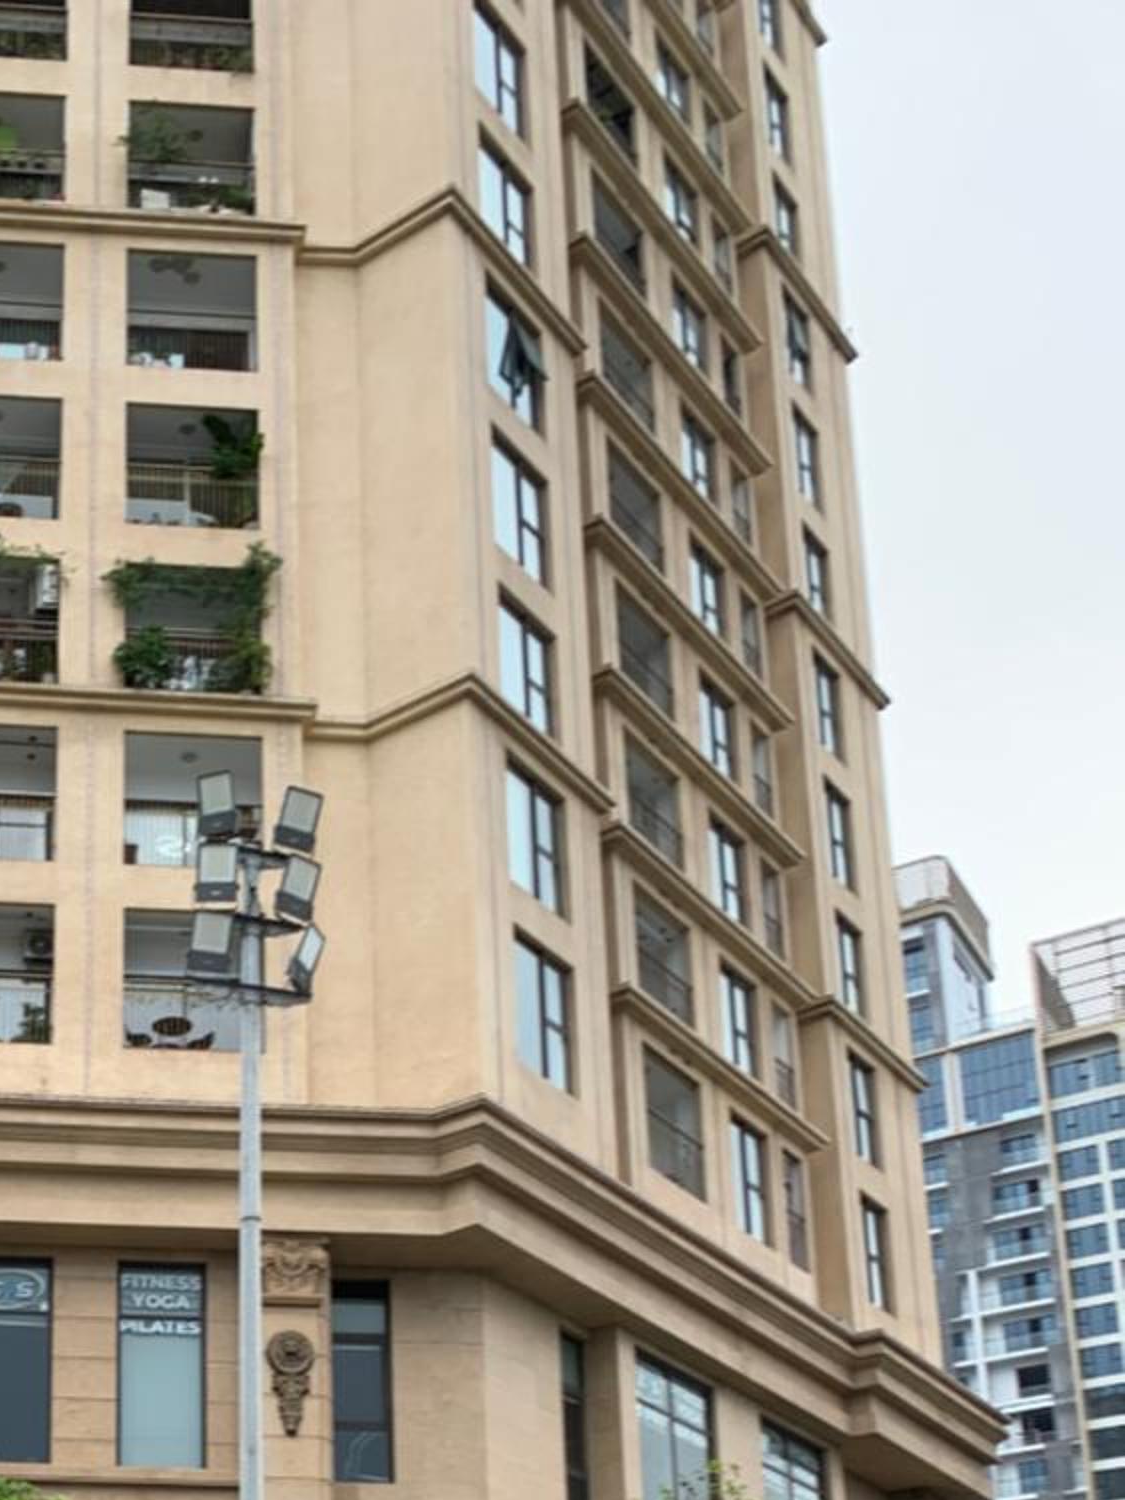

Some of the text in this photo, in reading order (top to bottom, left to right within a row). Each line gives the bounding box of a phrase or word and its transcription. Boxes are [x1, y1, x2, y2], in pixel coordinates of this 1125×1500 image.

[122, 1273, 202, 1290] FITNESS
[132, 1294, 191, 1309] YOGA
[120, 1319, 201, 1335] PILATES
